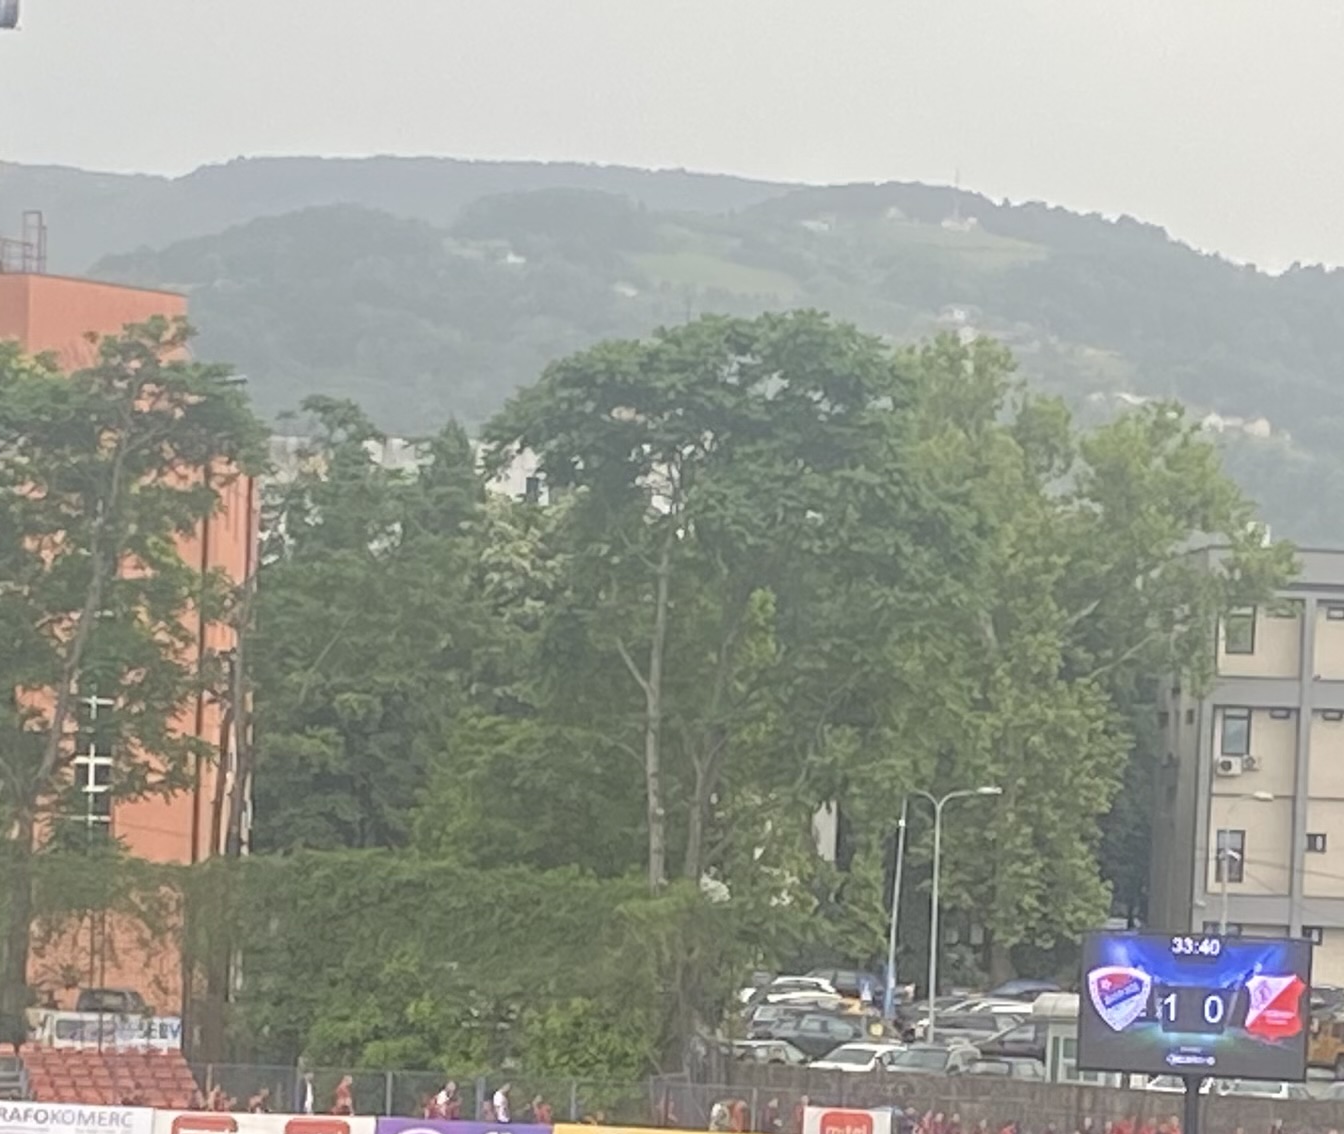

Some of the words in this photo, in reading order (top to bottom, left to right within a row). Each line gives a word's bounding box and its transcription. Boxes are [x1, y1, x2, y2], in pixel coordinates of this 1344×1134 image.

[1171, 936, 1222, 957] 33:40
[1163, 992, 1178, 1022] 1
[1203, 994, 1225, 1024] 0
